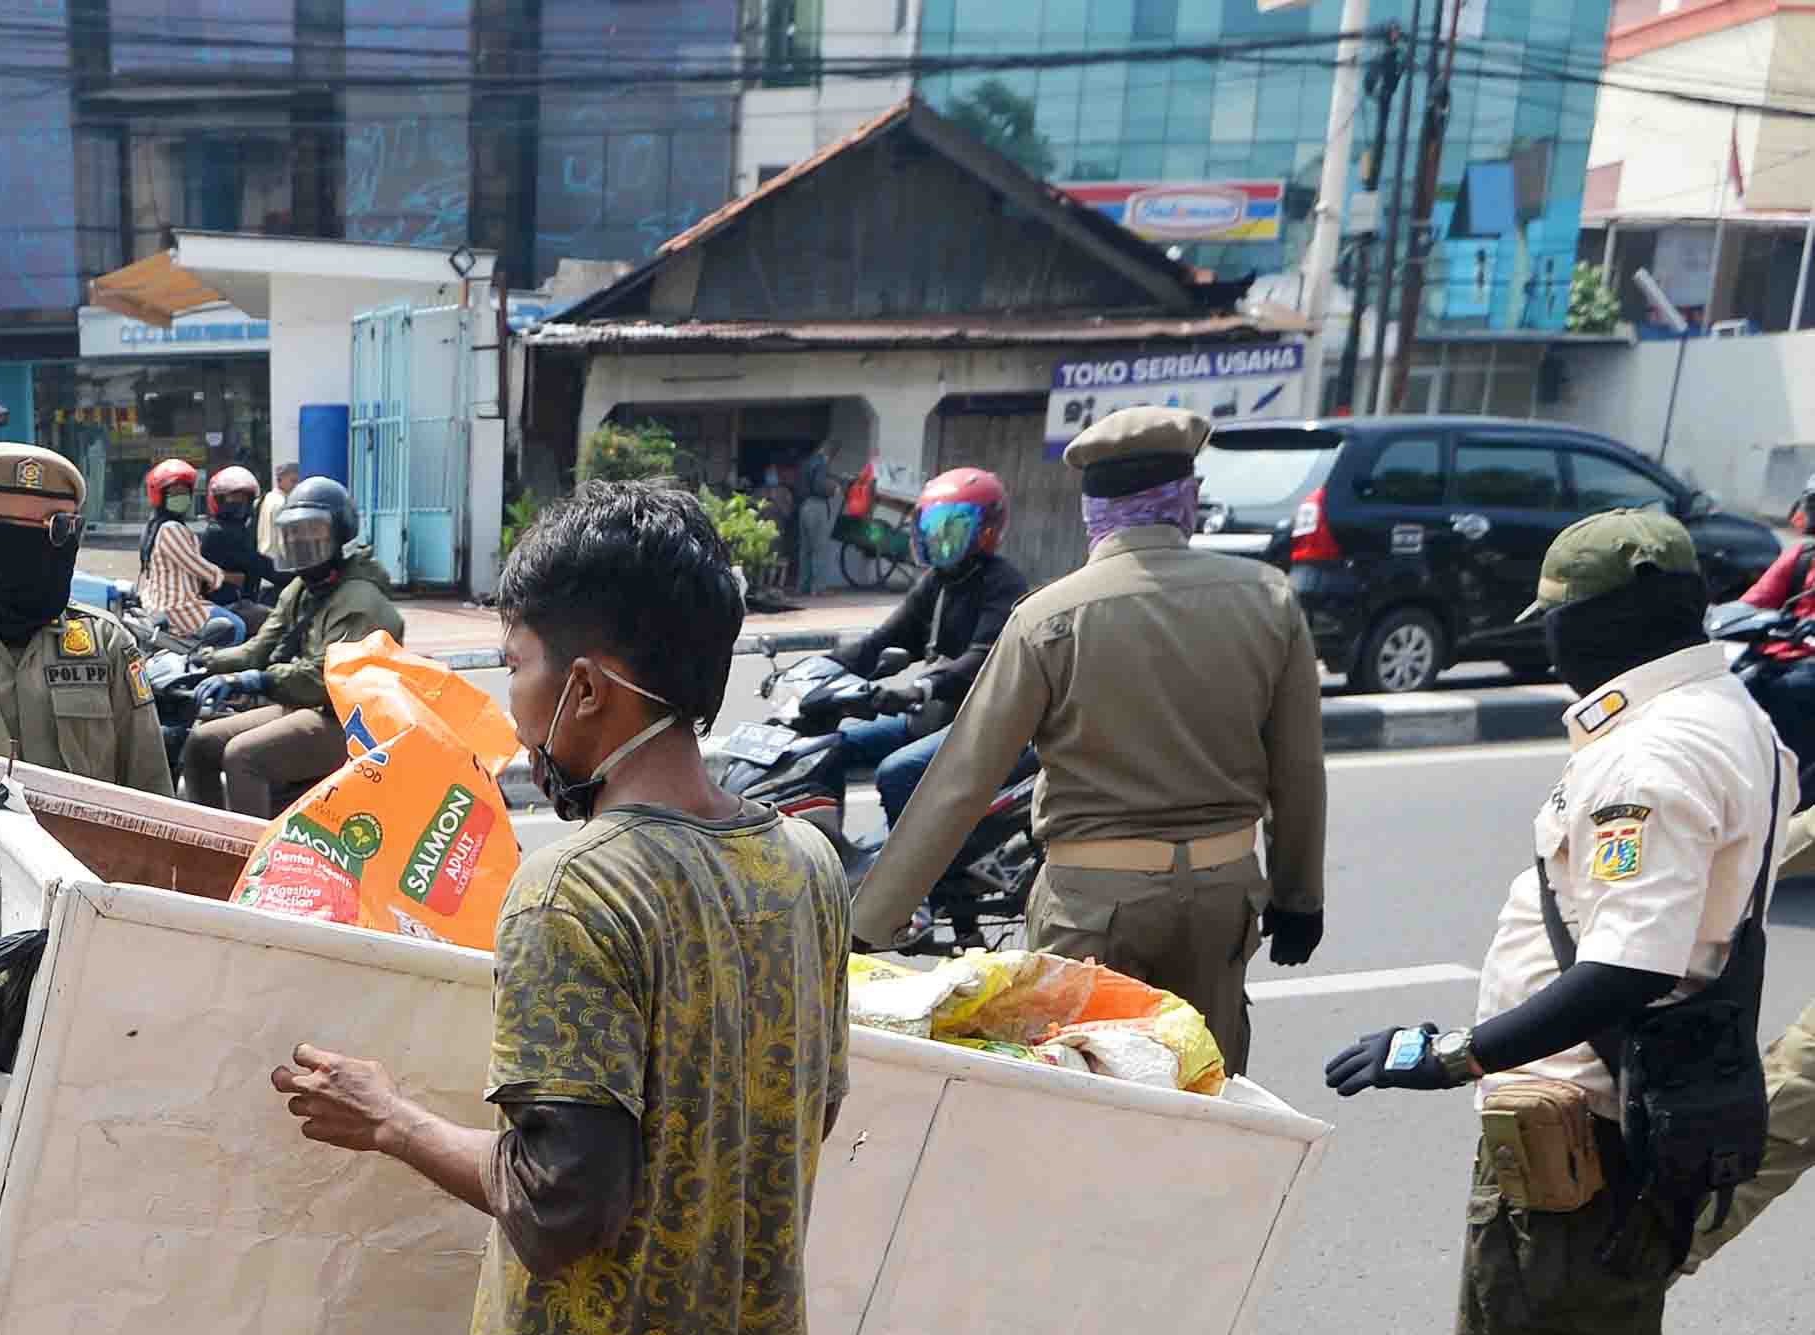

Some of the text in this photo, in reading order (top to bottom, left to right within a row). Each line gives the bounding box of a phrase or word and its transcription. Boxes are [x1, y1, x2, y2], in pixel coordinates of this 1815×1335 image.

[1060, 346, 1295, 386] TOKO SERBA USAHA
[48, 666, 107, 683] POL PP
[407, 789, 472, 894] SALMON
[445, 831, 476, 881] ADULT
[273, 849, 314, 866] Dental
[317, 858, 353, 889] Health
